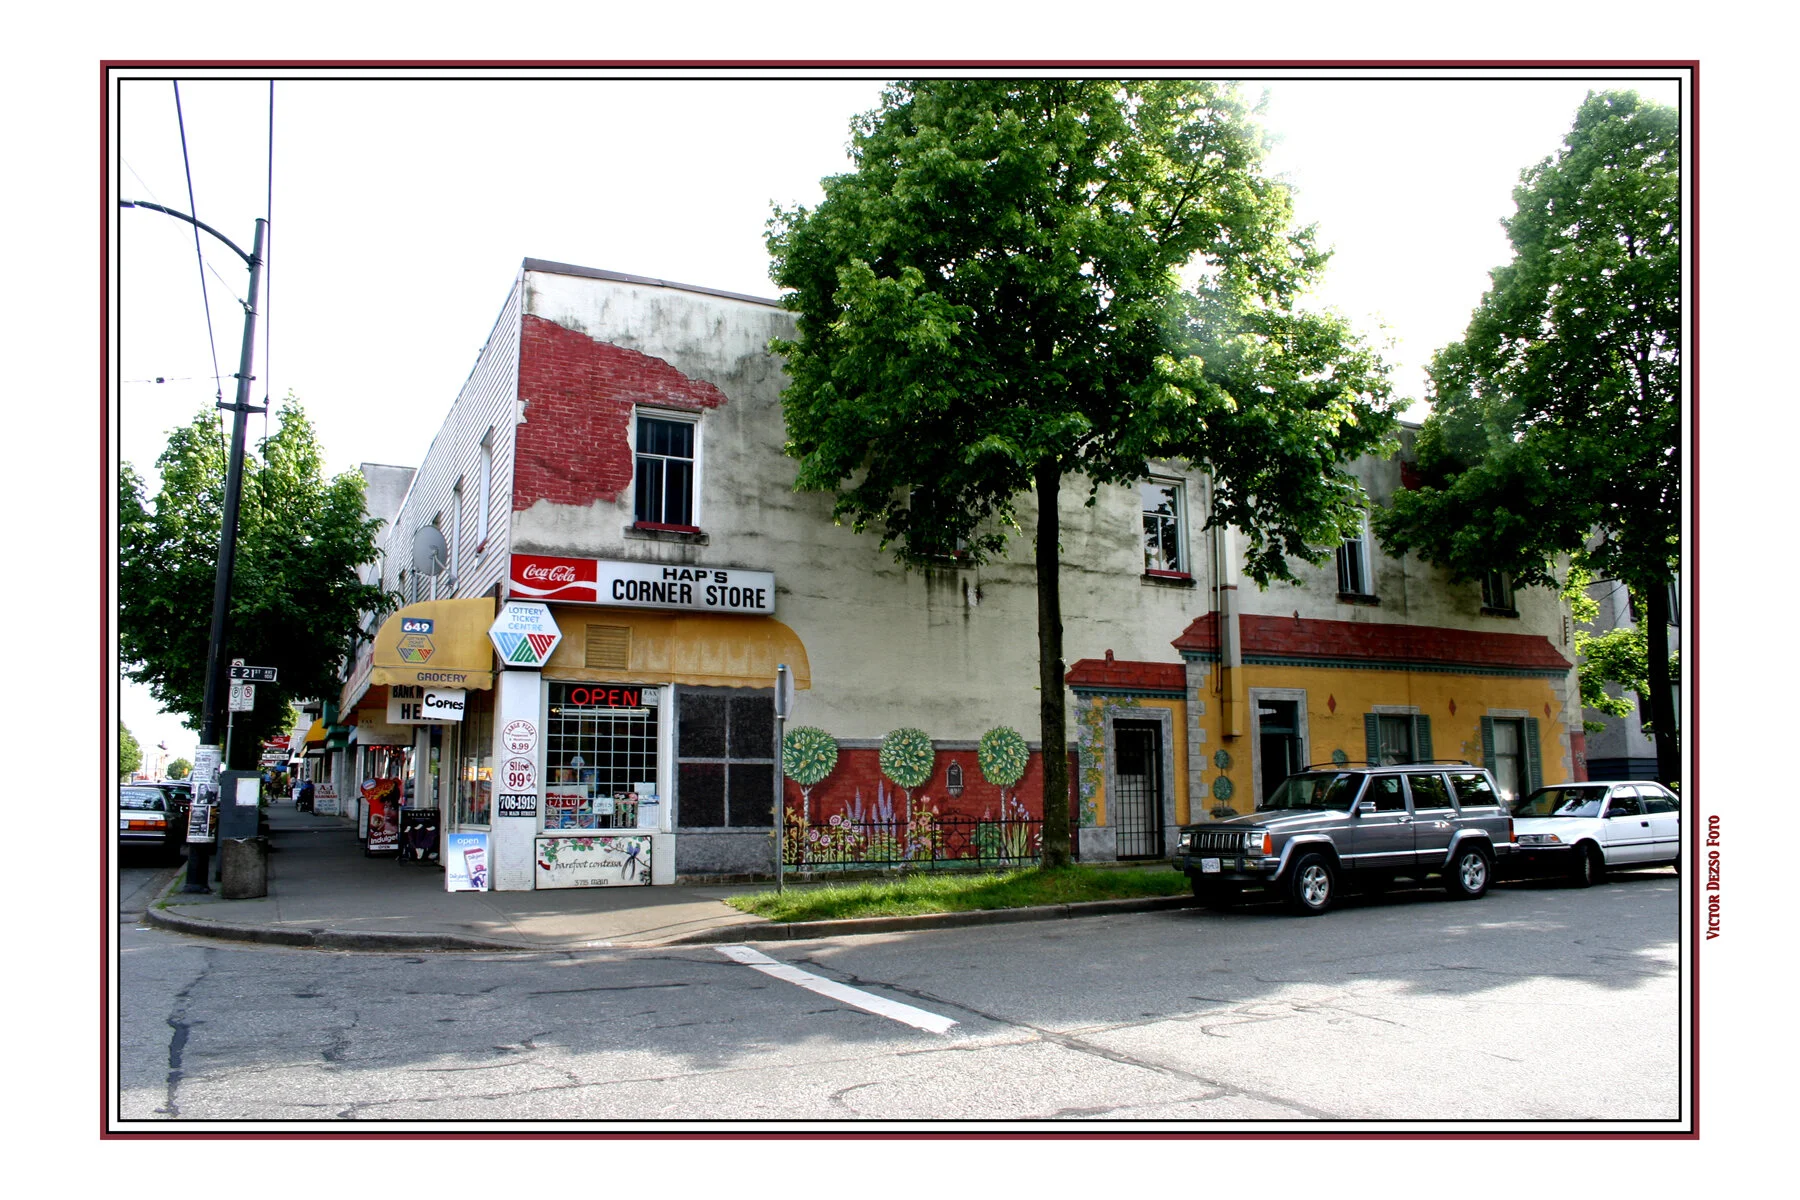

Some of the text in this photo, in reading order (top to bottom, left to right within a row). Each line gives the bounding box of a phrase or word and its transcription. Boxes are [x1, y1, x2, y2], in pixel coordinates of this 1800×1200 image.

[522, 563, 576, 582] Coca-Cola
[663, 568, 728, 583] HAP'S
[612, 579, 766, 609] CORNER STORE
[508, 607, 544, 615] LOTTERY
[512, 615, 540, 623] TICKET
[403, 621, 430, 632] 649
[508, 623, 543, 631] CENTRE
[230, 668, 237, 677] E
[417, 672, 467, 683] GROCERY
[392, 685, 415, 698] BANK
[644, 689, 657, 697] FAX
[571, 688, 638, 707] OPEN
[511, 743, 529, 751] 8.99
[509, 761, 529, 771] Slice
[500, 795, 537, 810] 708-1919
[370, 833, 398, 844] Indulge!
[457, 837, 479, 846] open
[555, 859, 622, 874] barefoot contessa
